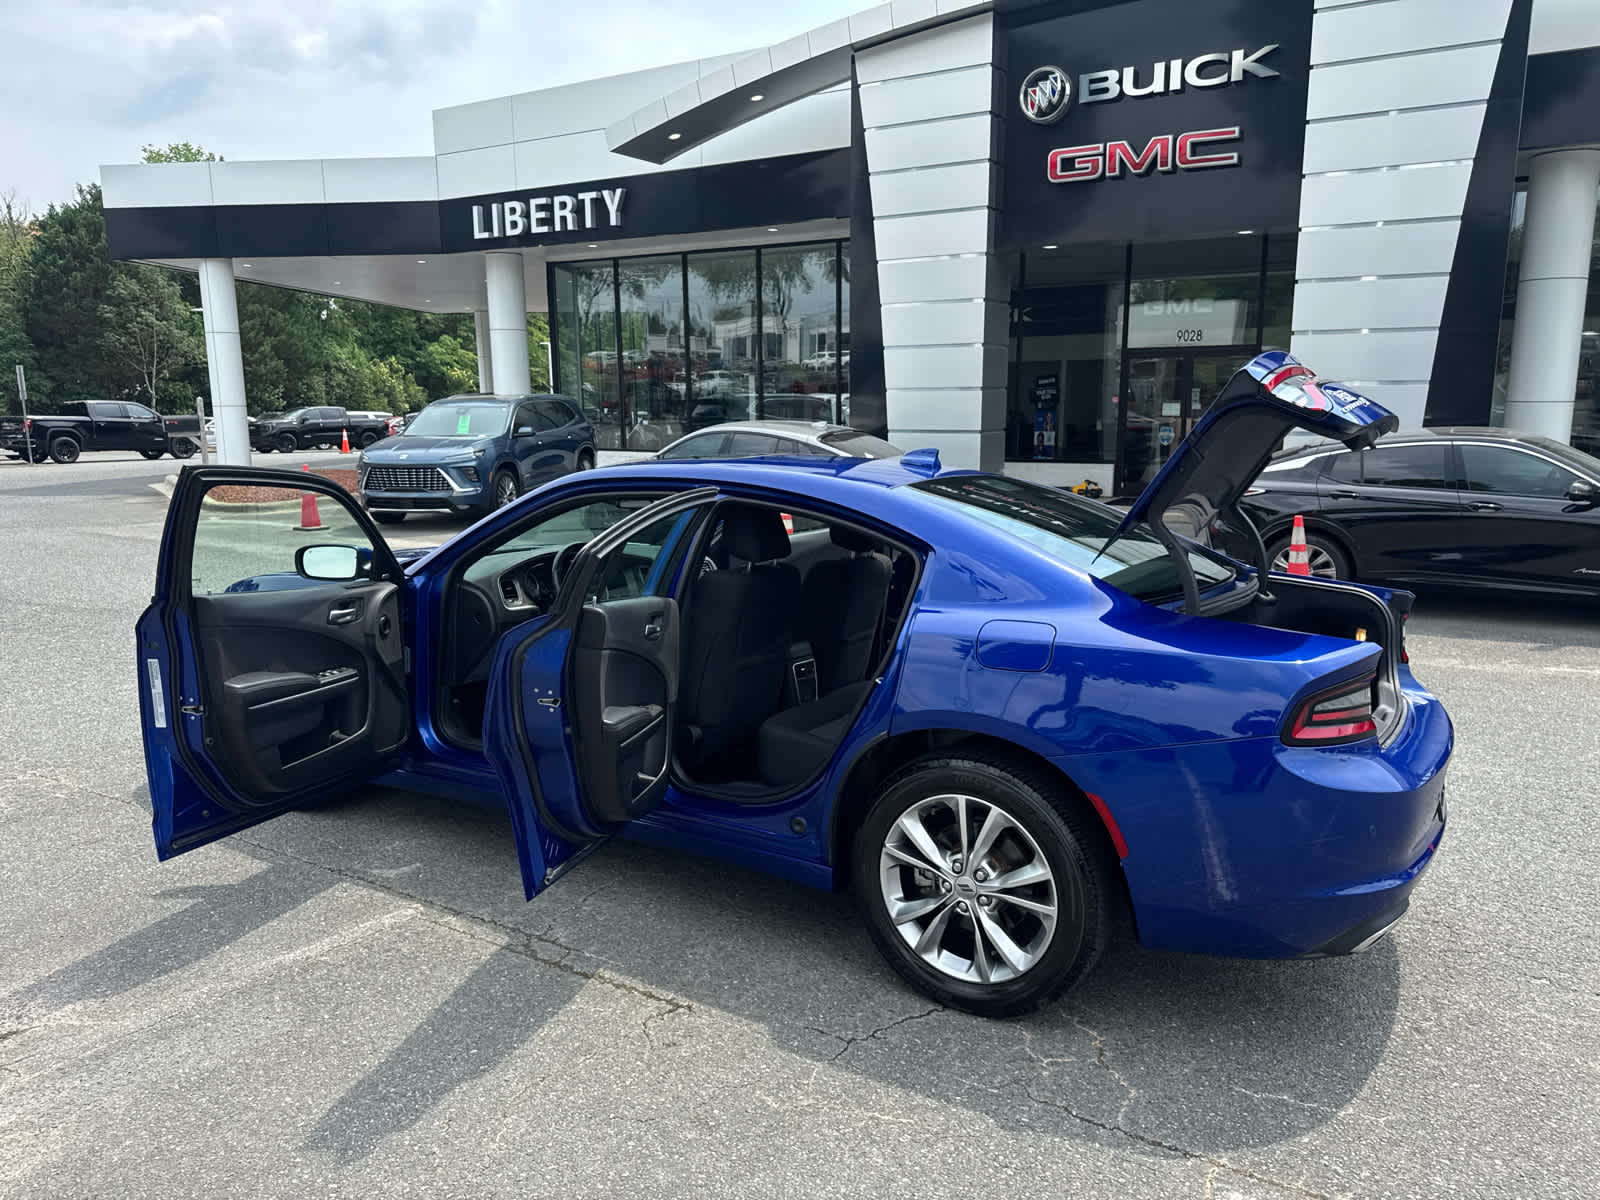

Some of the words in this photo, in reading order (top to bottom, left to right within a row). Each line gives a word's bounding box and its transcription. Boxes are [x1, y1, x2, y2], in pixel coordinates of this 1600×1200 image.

[1078, 43, 1280, 105] BUICK
[1047, 126, 1240, 183] GMC
[471, 187, 626, 240] LIBERTY
[1176, 329, 1203, 342] 9028
